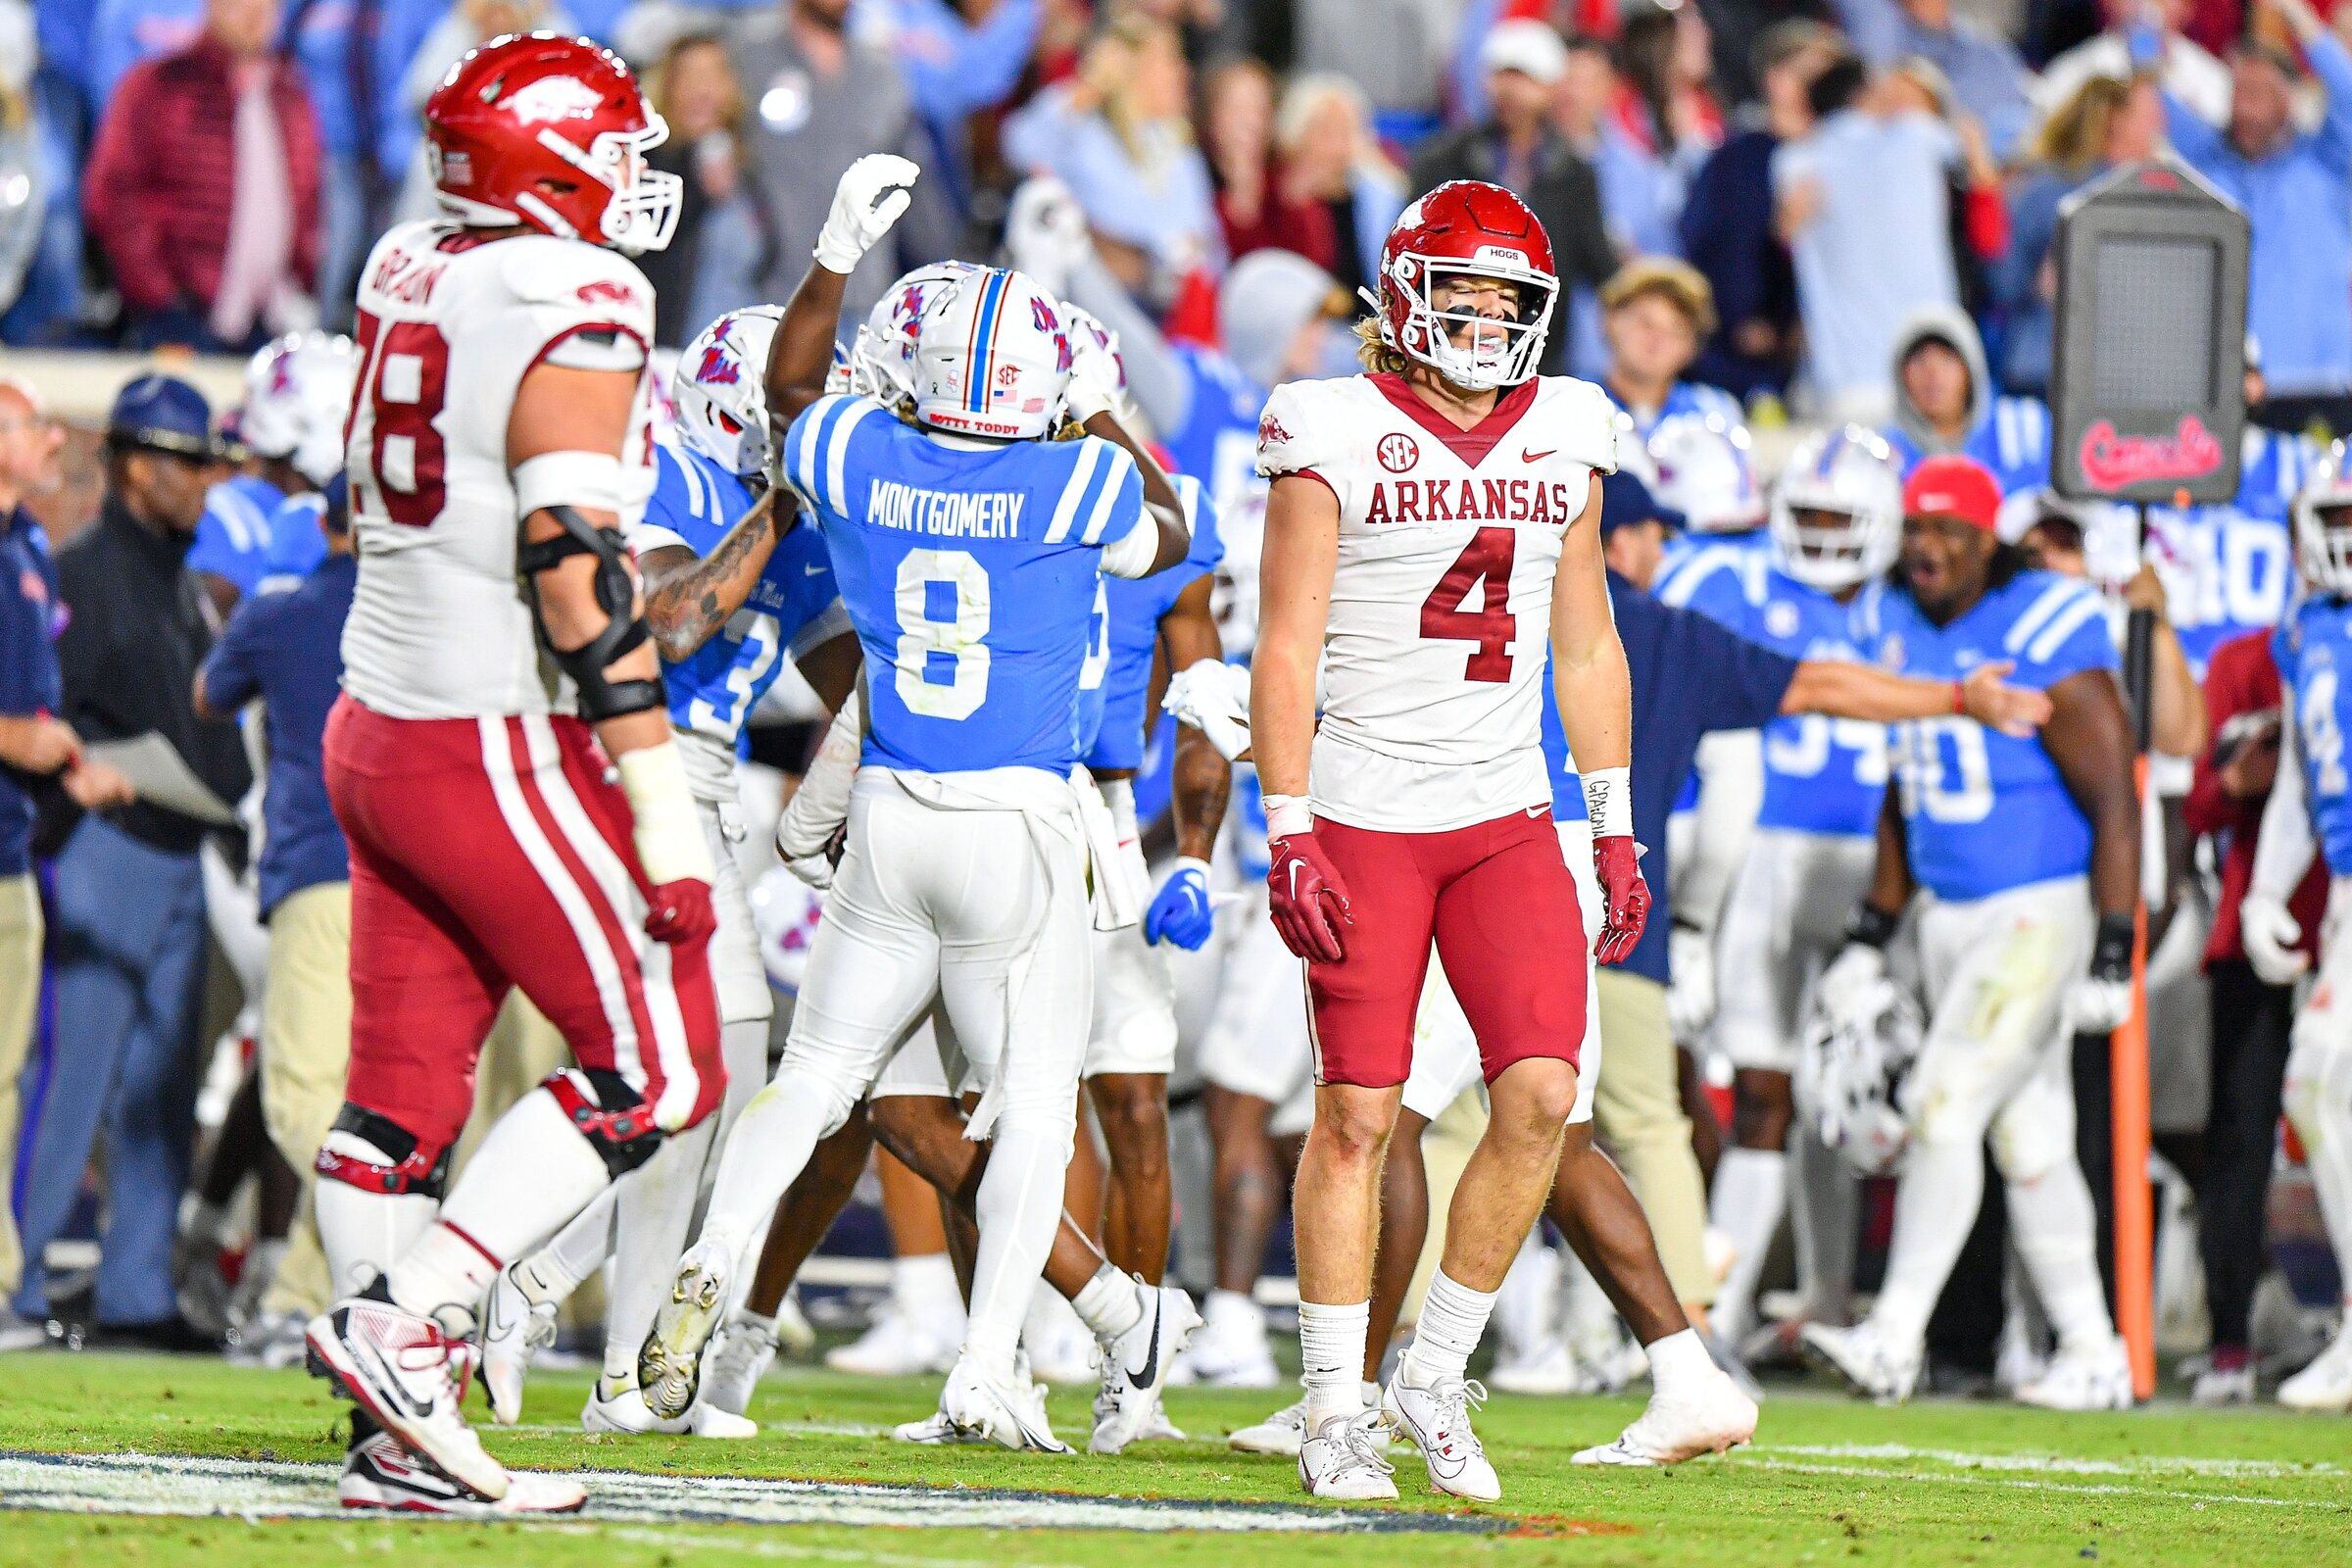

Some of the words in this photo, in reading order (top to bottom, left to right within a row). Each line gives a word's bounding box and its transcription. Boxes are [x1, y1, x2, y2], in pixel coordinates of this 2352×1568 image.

[1490, 248, 1519, 261] HOGS
[343, 307, 450, 527] 78
[974, 421, 1019, 435] TODDY
[1378, 433, 1418, 472] SEC
[867, 478, 1025, 539] MONTGOMERY
[1366, 478, 1569, 525] ARKANSAS
[894, 547, 990, 722] 8
[1420, 526, 1517, 684] 4
[689, 608, 780, 743] 3
